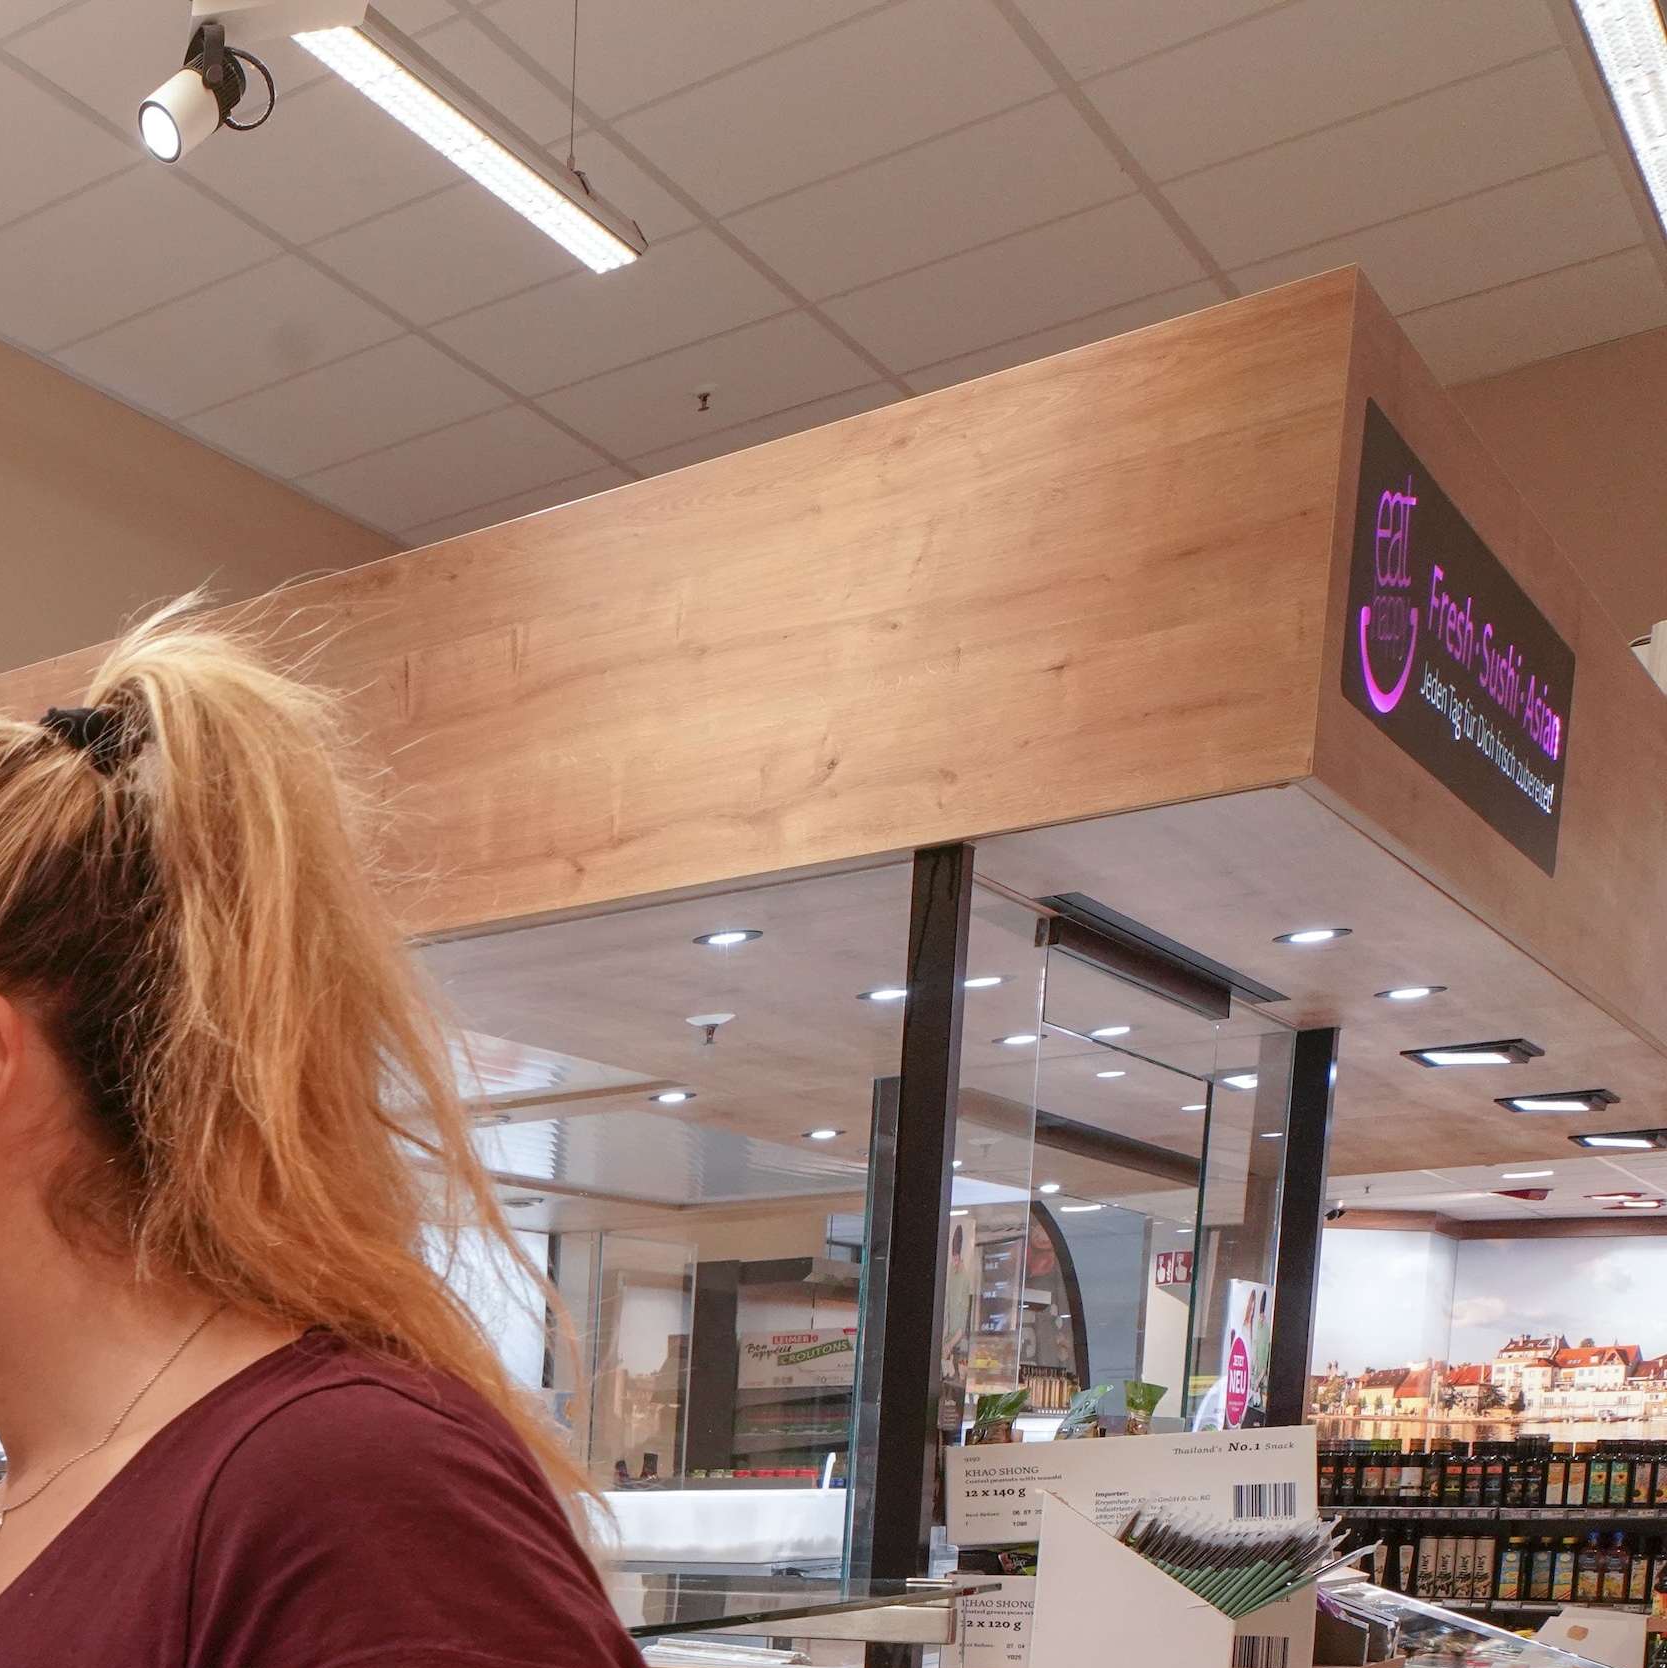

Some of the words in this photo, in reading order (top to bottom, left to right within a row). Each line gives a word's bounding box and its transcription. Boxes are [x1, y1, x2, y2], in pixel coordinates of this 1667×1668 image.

[1376, 475, 1417, 587] eat
[1428, 564, 1474, 670] Fresh
[1479, 623, 1523, 719] Sushi
[1523, 675, 1561, 761] Asian
[1420, 661, 1447, 714] Jeden
[1449, 684, 1463, 741] Tag
[1463, 698, 1475, 739] für
[1476, 714, 1494, 760] Dich
[1495, 730, 1516, 780] frisch
[1516, 758, 1554, 814] zubereitet!
[781, 1341, 848, 1362] CROUTONS
[1229, 1369, 1246, 1394] NEU
[1173, 1445, 1222, 1456] Thailand's
[1228, 1442, 1260, 1452] No.1
[1265, 1442, 1294, 1450] Snack
[965, 1469, 996, 1478] KHAO
[999, 1466, 1039, 1476] SHONG
[965, 1490, 978, 1498] 12
[993, 1488, 1015, 1498] 140
[1018, 1487, 1026, 1497] g
[1014, 1621, 1022, 1631] g
